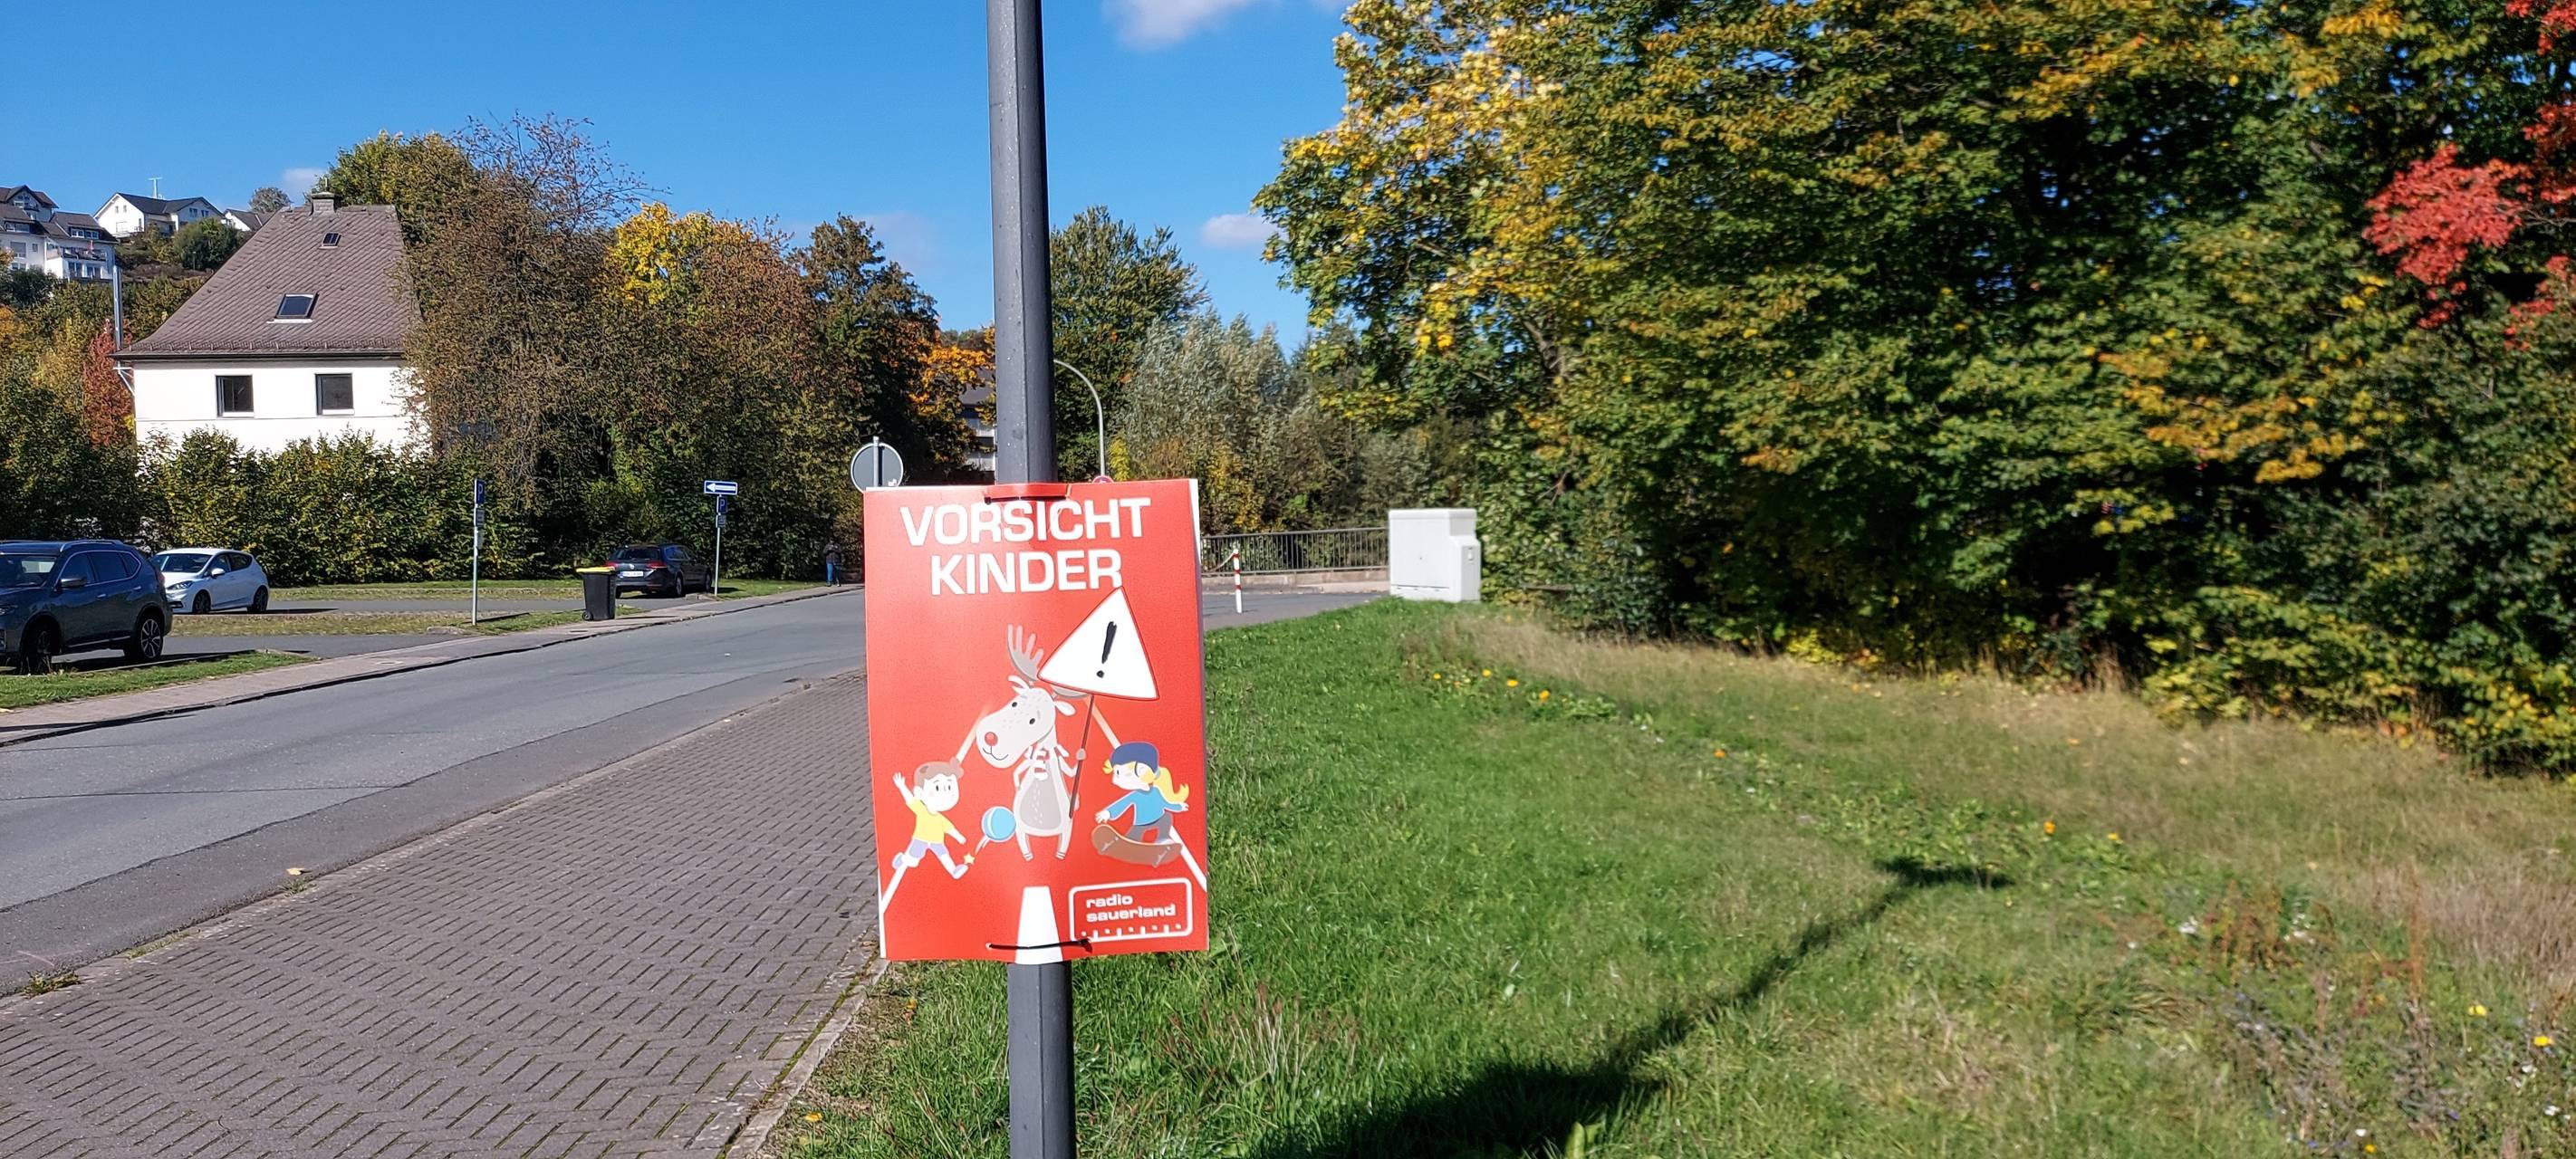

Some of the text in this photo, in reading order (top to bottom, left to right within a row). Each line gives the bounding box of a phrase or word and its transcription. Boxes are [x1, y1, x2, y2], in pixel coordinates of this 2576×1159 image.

[899, 497, 1151, 547] VORSICHT
[930, 548, 1123, 596] KINDER
[1086, 893, 1133, 909] radio
[1086, 903, 1177, 923] sauerland
